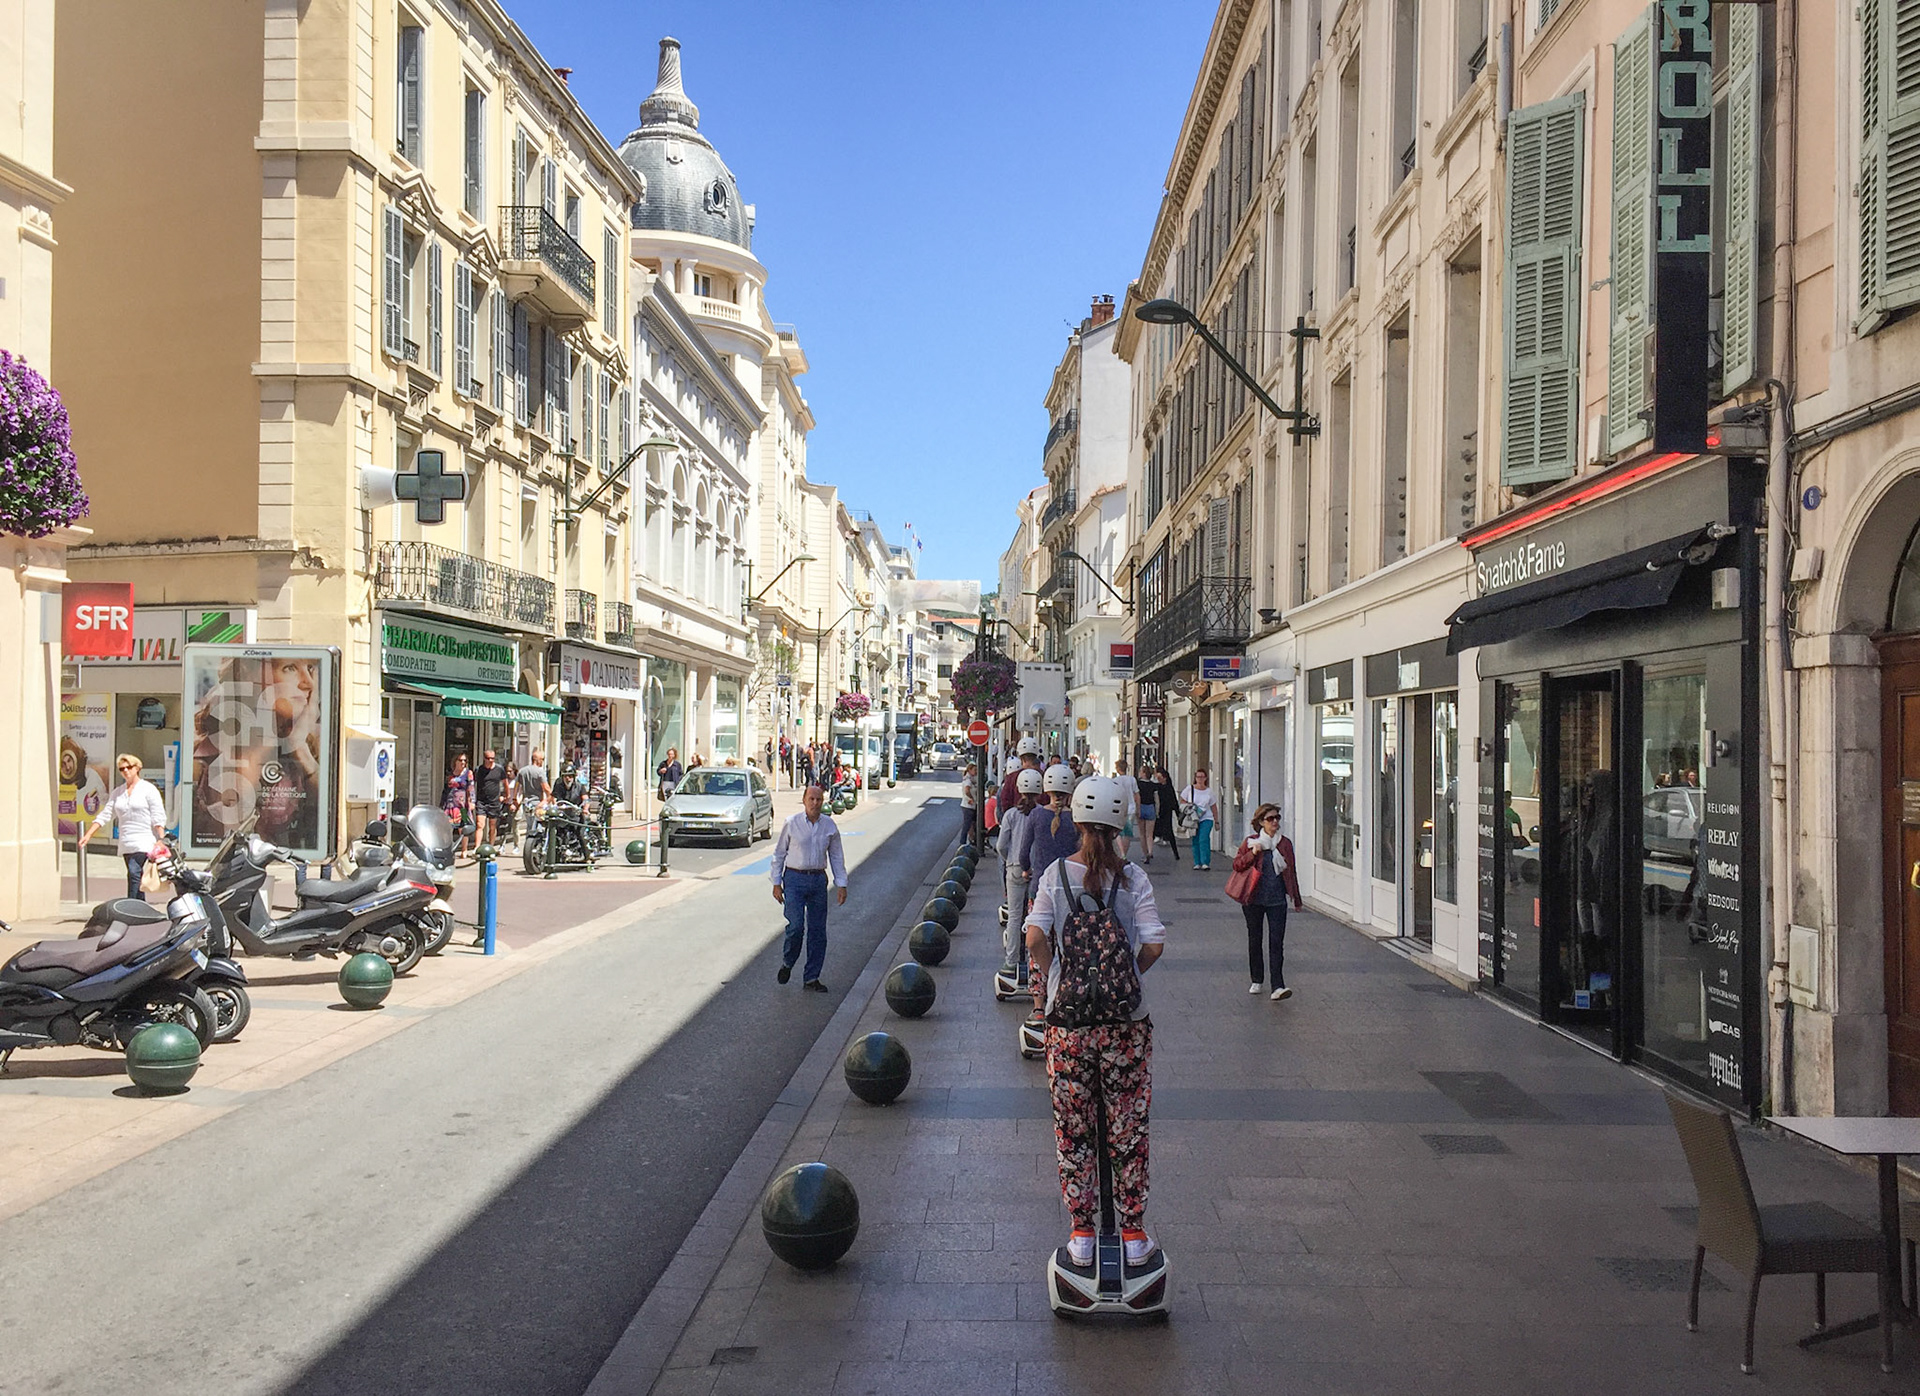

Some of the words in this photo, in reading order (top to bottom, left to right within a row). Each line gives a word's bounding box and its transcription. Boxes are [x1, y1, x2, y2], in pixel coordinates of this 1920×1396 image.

[1477, 541, 1566, 593] Snatch&Fame
[75, 605, 129, 631] SFR
[382, 624, 456, 657] PHARMACIE
[468, 640, 515, 667] FESTIVAL
[575, 658, 579, 684] I
[591, 660, 630, 691] CANNES
[1207, 670, 1236, 678] Change
[461, 703, 507, 719] PHARMACIE
[1707, 802, 1740, 815] RELIGION
[1707, 829, 1739, 847] REPLAY
[1721, 1022, 1741, 1039] GAS
